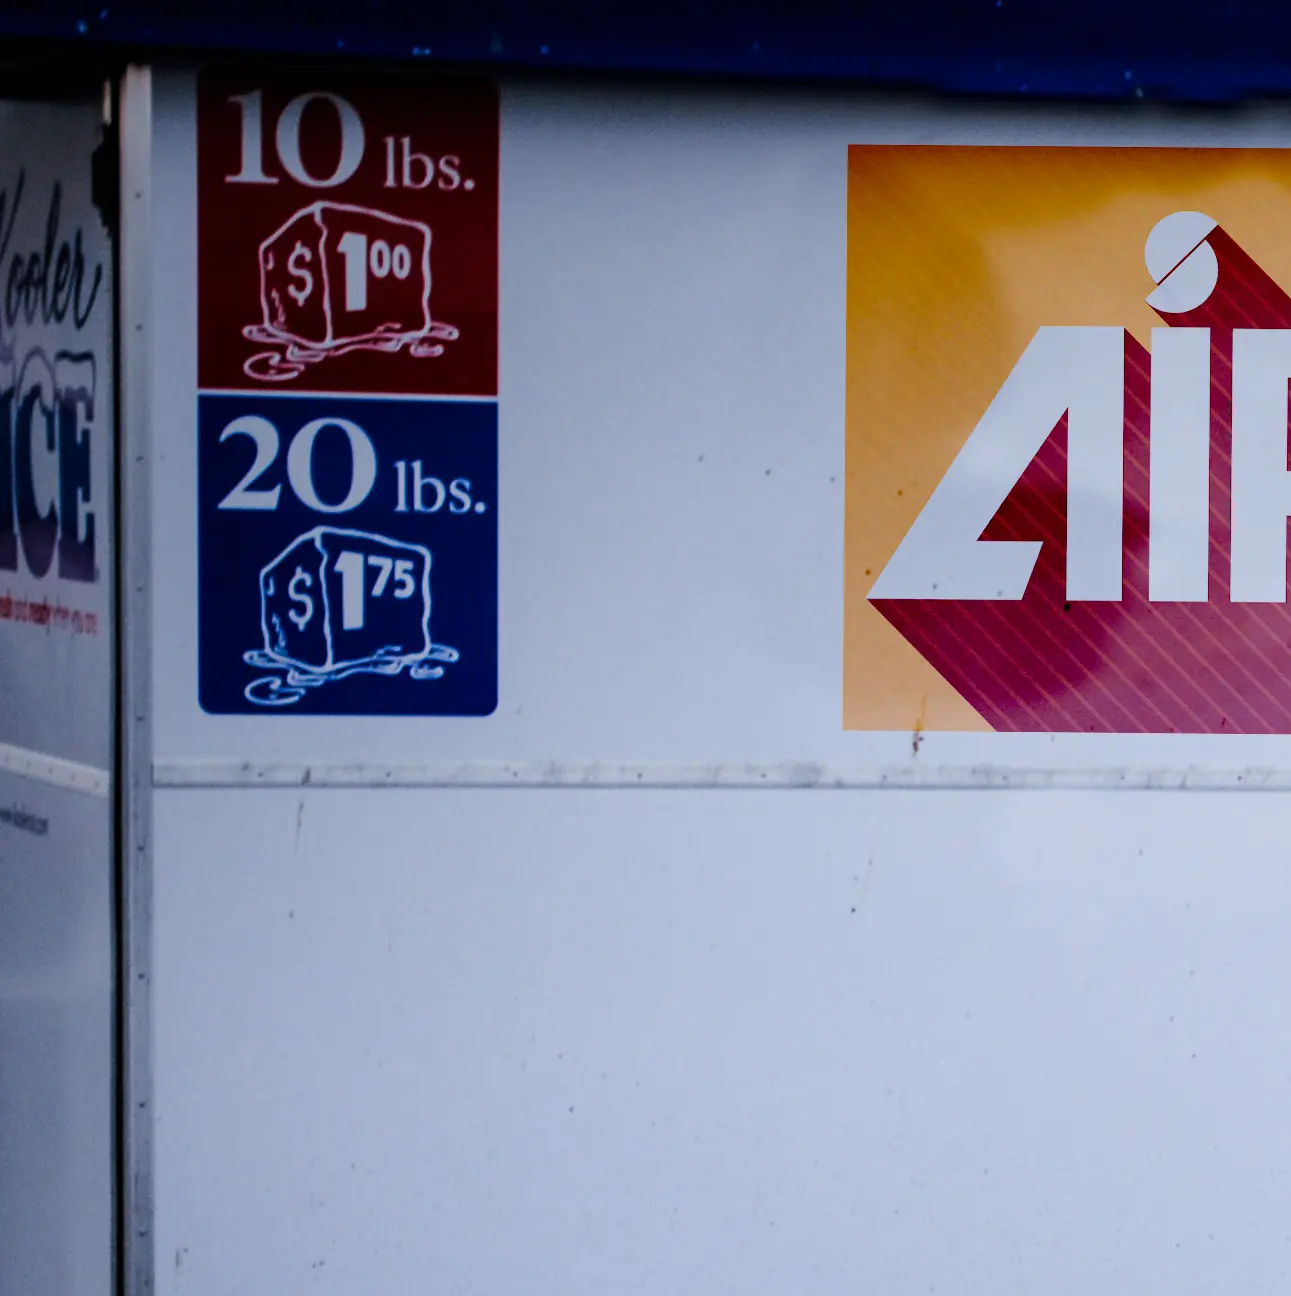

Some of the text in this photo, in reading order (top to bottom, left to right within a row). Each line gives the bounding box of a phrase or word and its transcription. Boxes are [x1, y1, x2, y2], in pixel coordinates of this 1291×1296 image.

[225, 89, 475, 190] 10 lbs.
[217, 415, 487, 514] 20 lbs.
